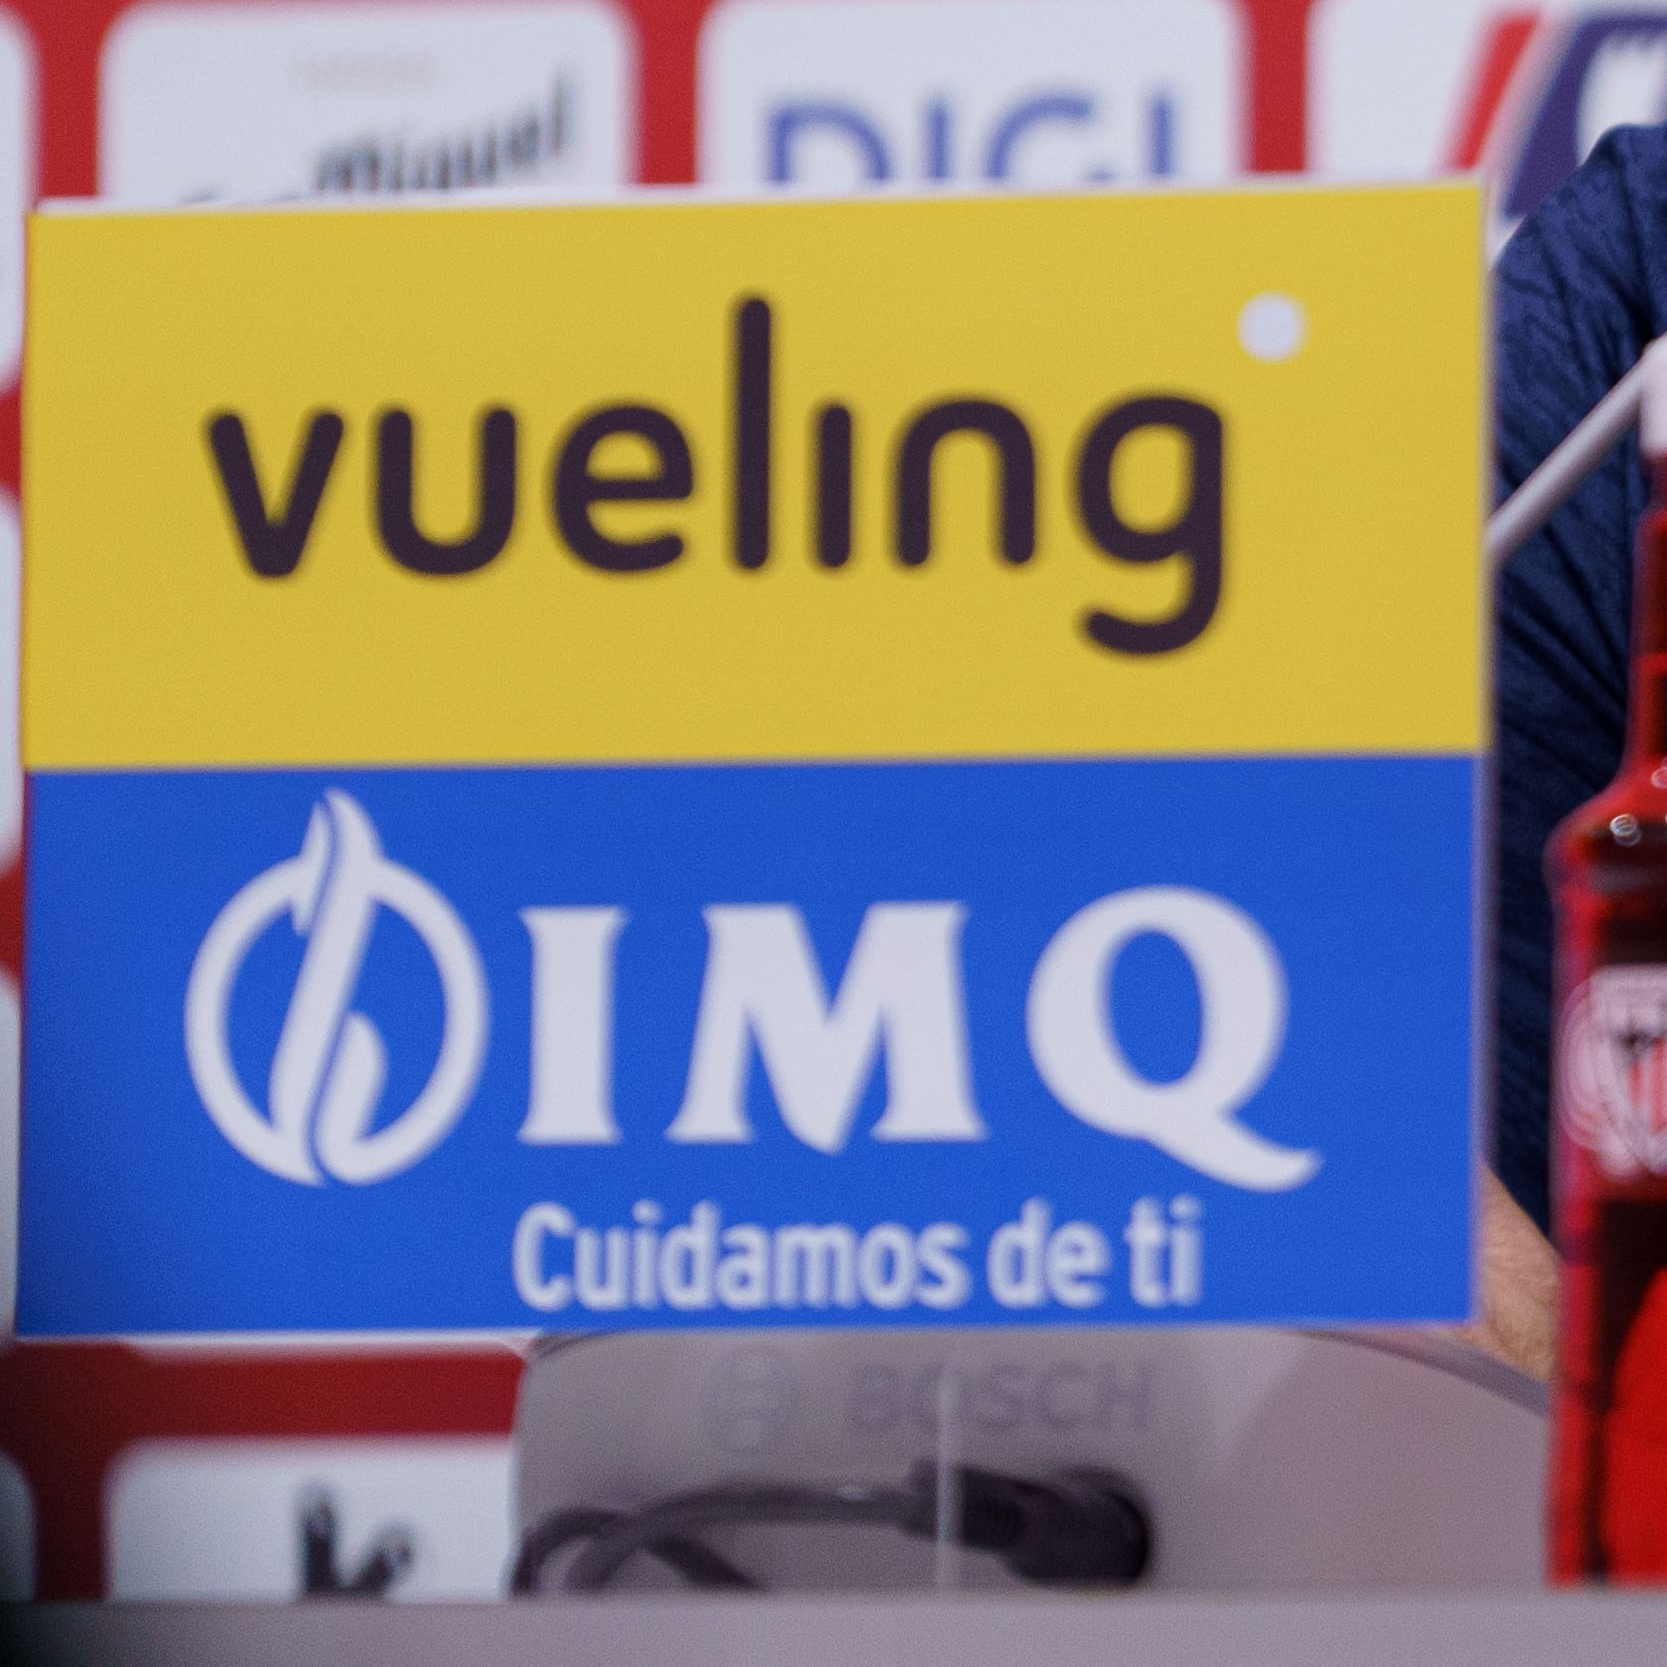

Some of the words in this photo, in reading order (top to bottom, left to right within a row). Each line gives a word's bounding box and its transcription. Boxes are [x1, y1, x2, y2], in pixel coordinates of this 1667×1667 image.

[205, 291, 1225, 656] vueling
[518, 885, 1322, 1192] IMQ
[512, 1199, 971, 1311] Cuidamos
[985, 1196, 1110, 1308] de
[1125, 1193, 1201, 1308] ti
[846, 1362, 1158, 1433] BOSCH
